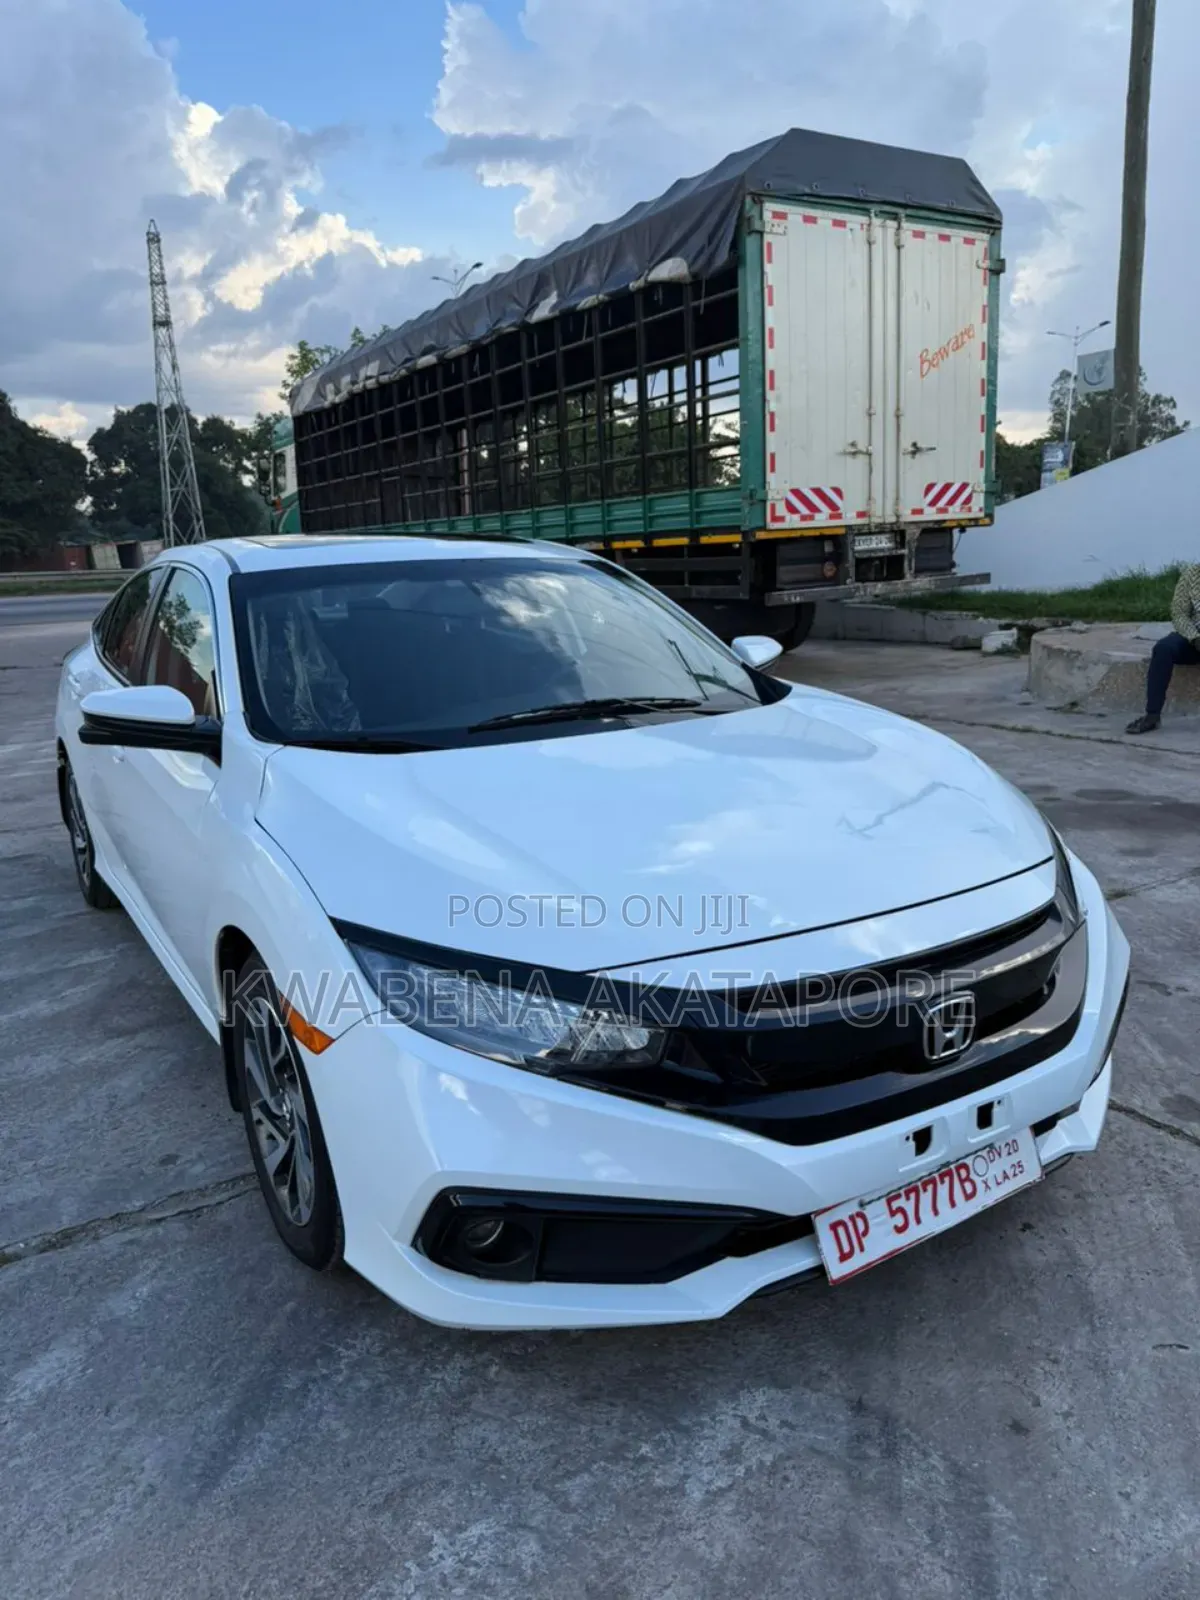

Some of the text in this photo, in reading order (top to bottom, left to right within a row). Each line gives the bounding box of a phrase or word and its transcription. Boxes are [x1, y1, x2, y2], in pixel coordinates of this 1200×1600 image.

[918, 323, 976, 379] Beware
[987, 1138, 1020, 1163] DV 20
[829, 1161, 978, 1263] DP 5777B
